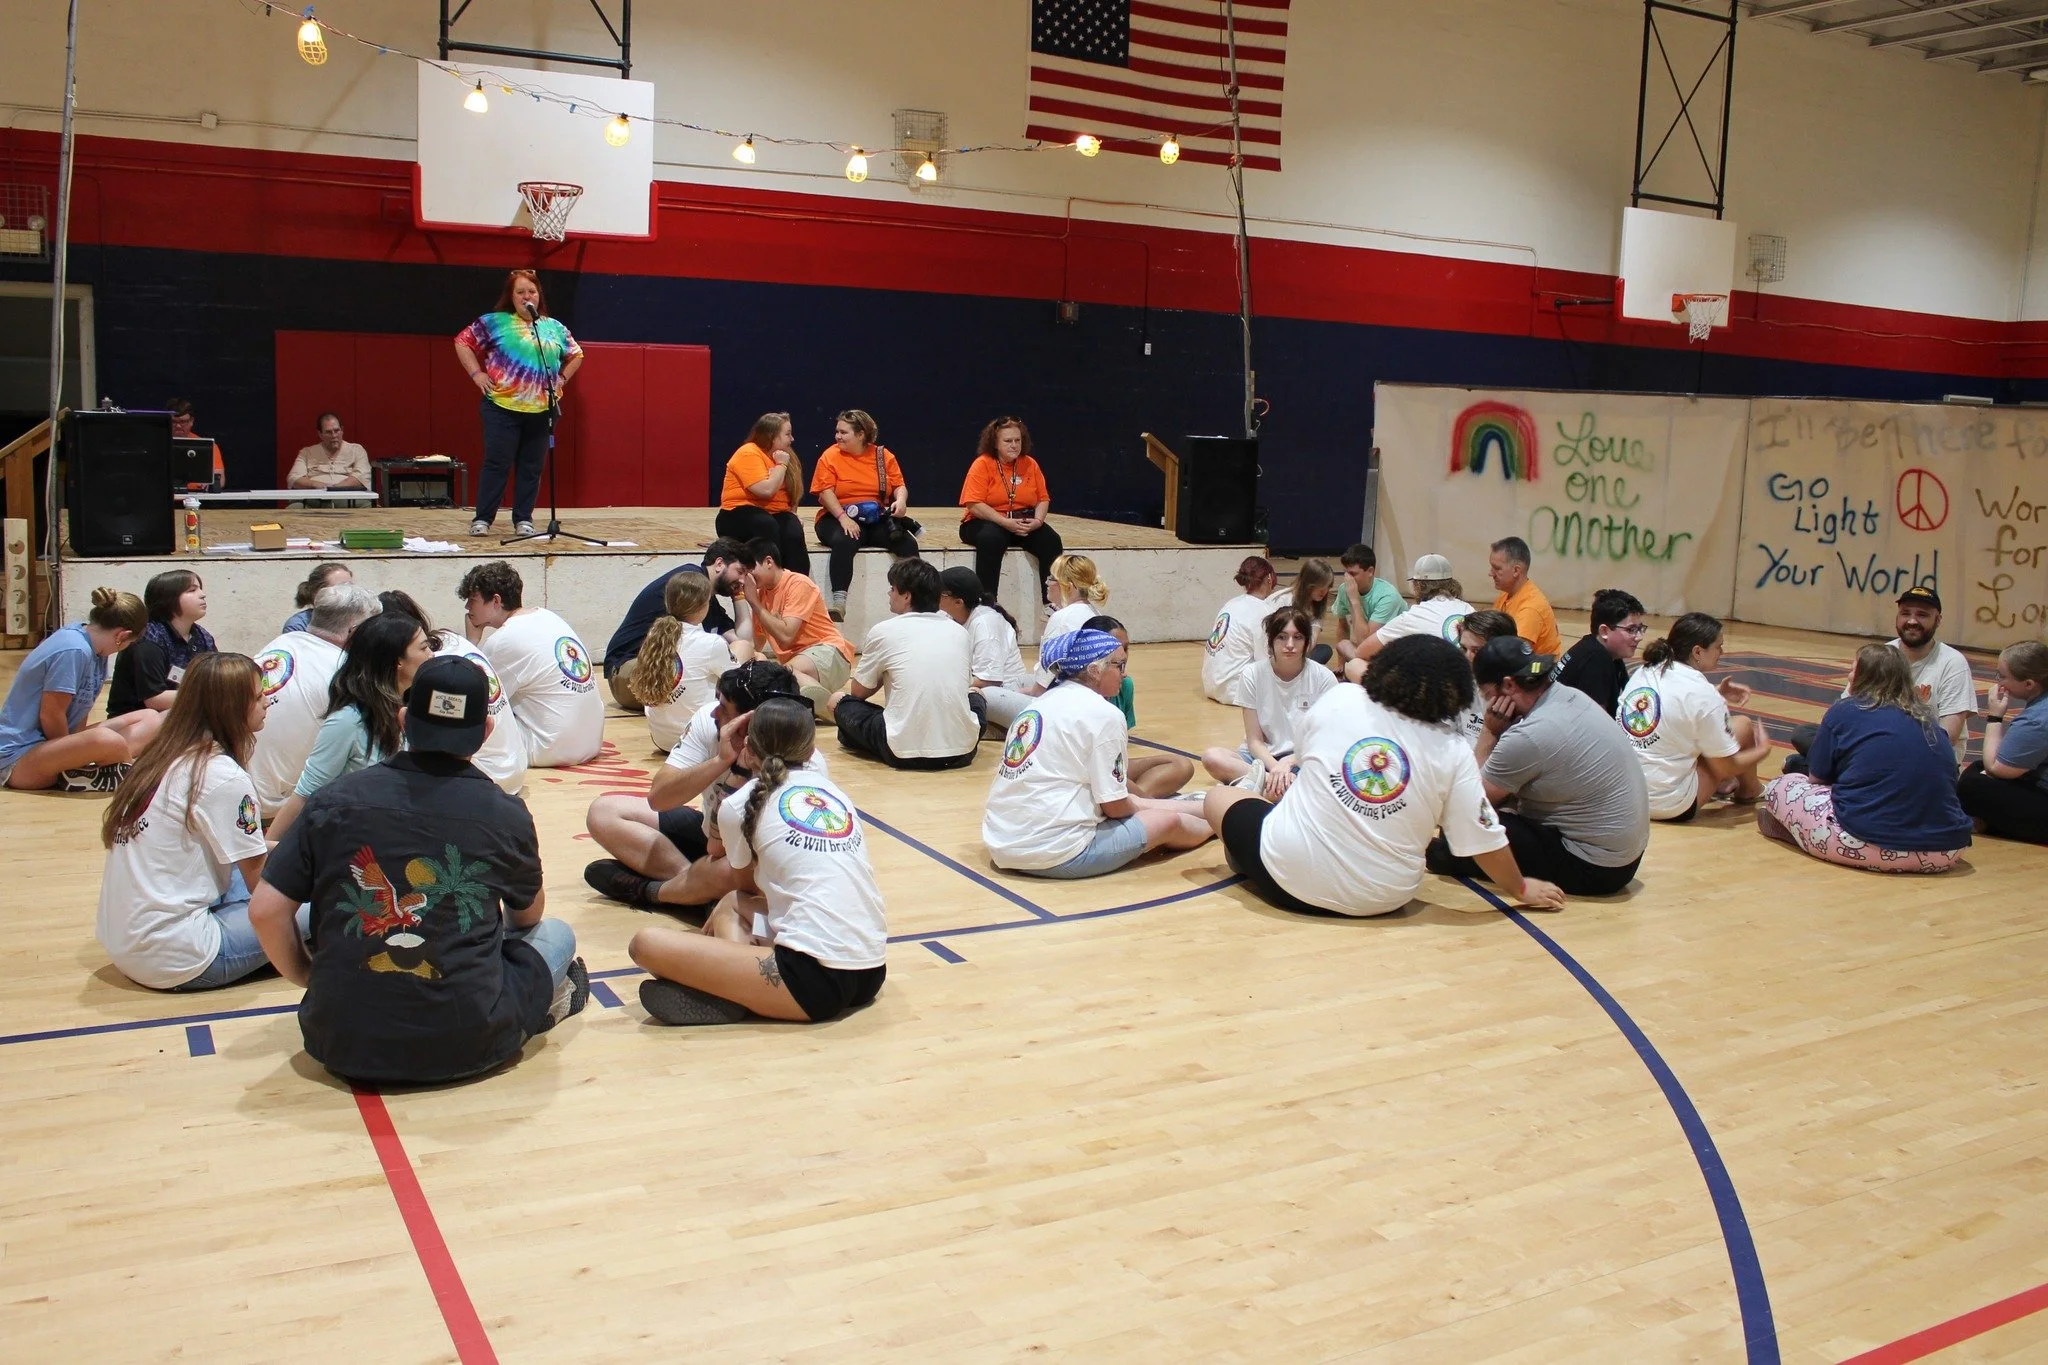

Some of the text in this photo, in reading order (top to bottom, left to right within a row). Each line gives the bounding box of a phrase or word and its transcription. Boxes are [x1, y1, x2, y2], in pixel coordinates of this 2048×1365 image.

[1553, 411, 1655, 472] Love
[1565, 471, 1641, 510] one
[1767, 472, 1830, 501] Go
[1794, 496, 1881, 544] Light
[1755, 542, 1939, 596] Your World
[1335, 785, 1356, 808] Will
[1352, 801, 1380, 821] bring
[1380, 798, 1407, 819] Peace
[784, 829, 803, 847] He
[803, 835, 828, 853] Will
